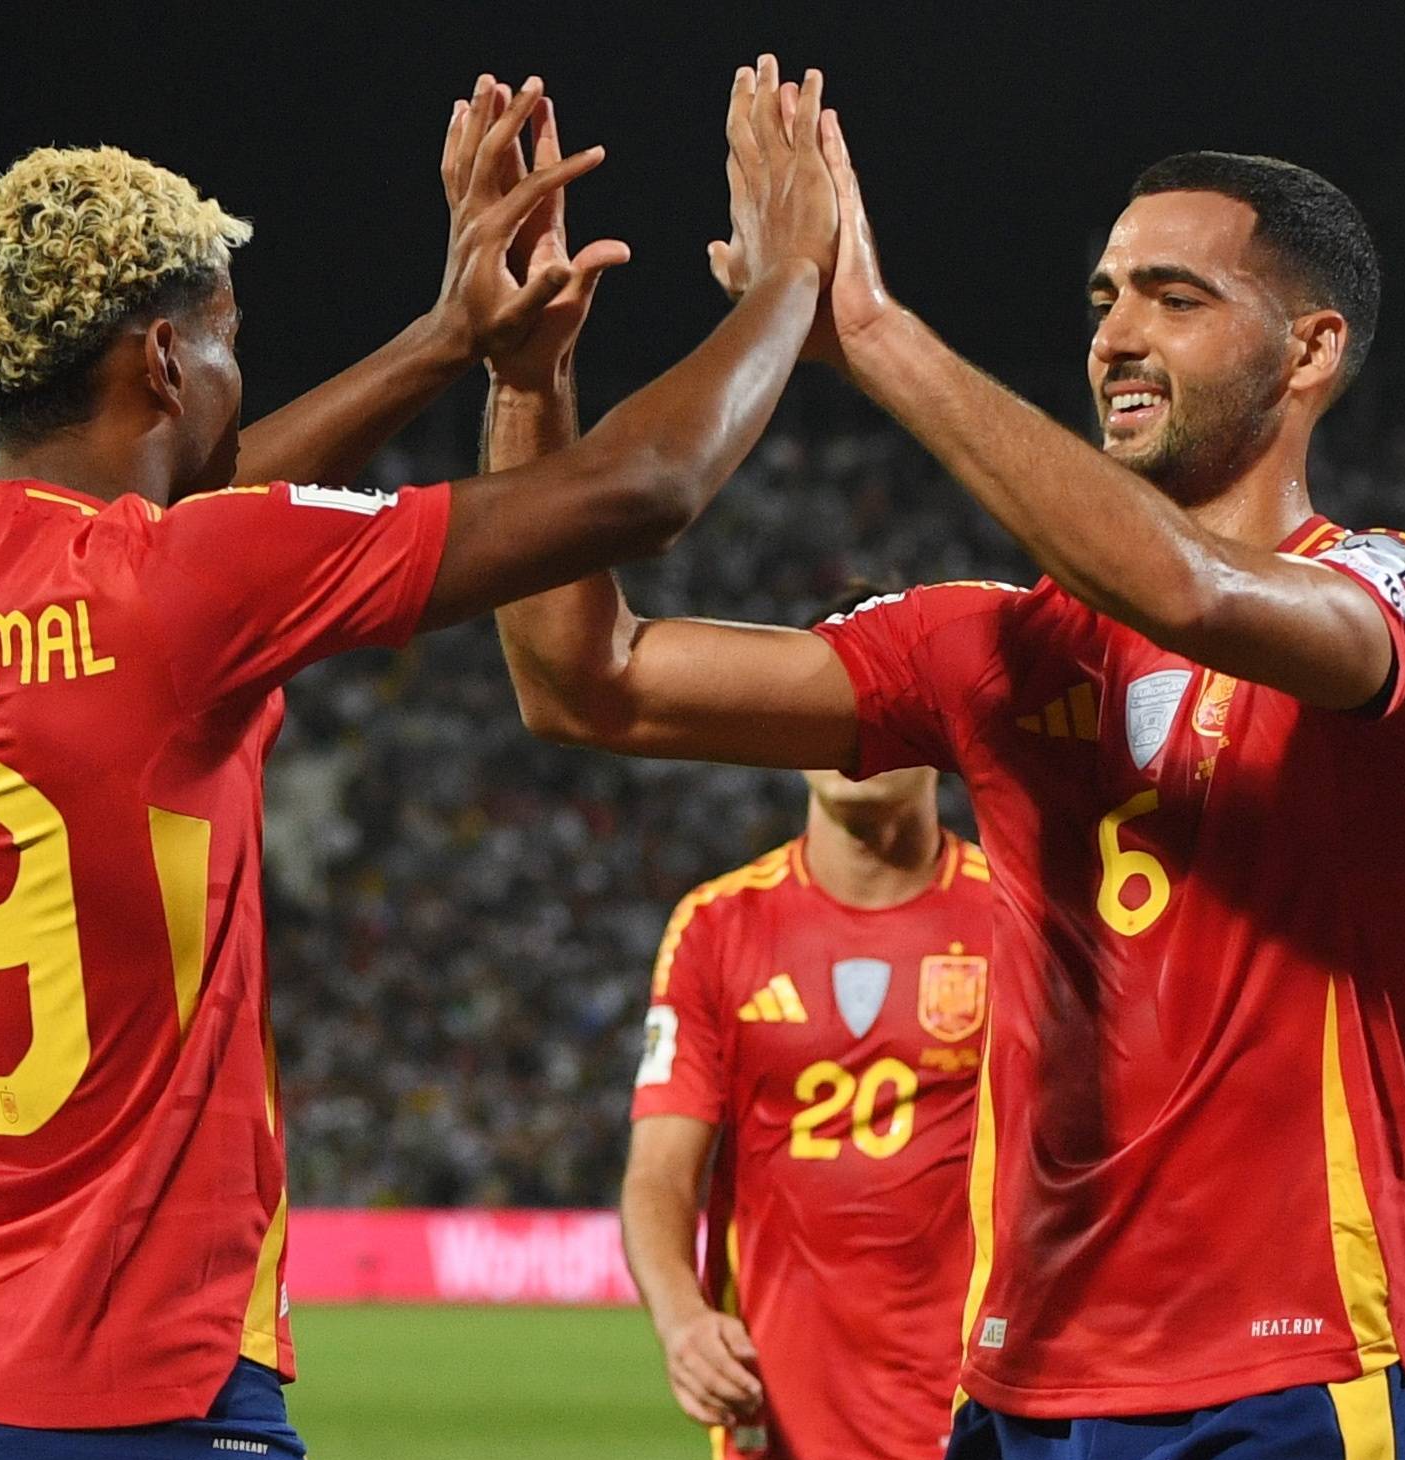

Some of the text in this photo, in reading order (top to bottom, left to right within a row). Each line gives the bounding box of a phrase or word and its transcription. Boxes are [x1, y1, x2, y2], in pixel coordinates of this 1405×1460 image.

[1097, 788, 1170, 937] 6
[789, 1056, 919, 1160] 20
[1251, 1317, 1324, 1338] HEAT.RDY
